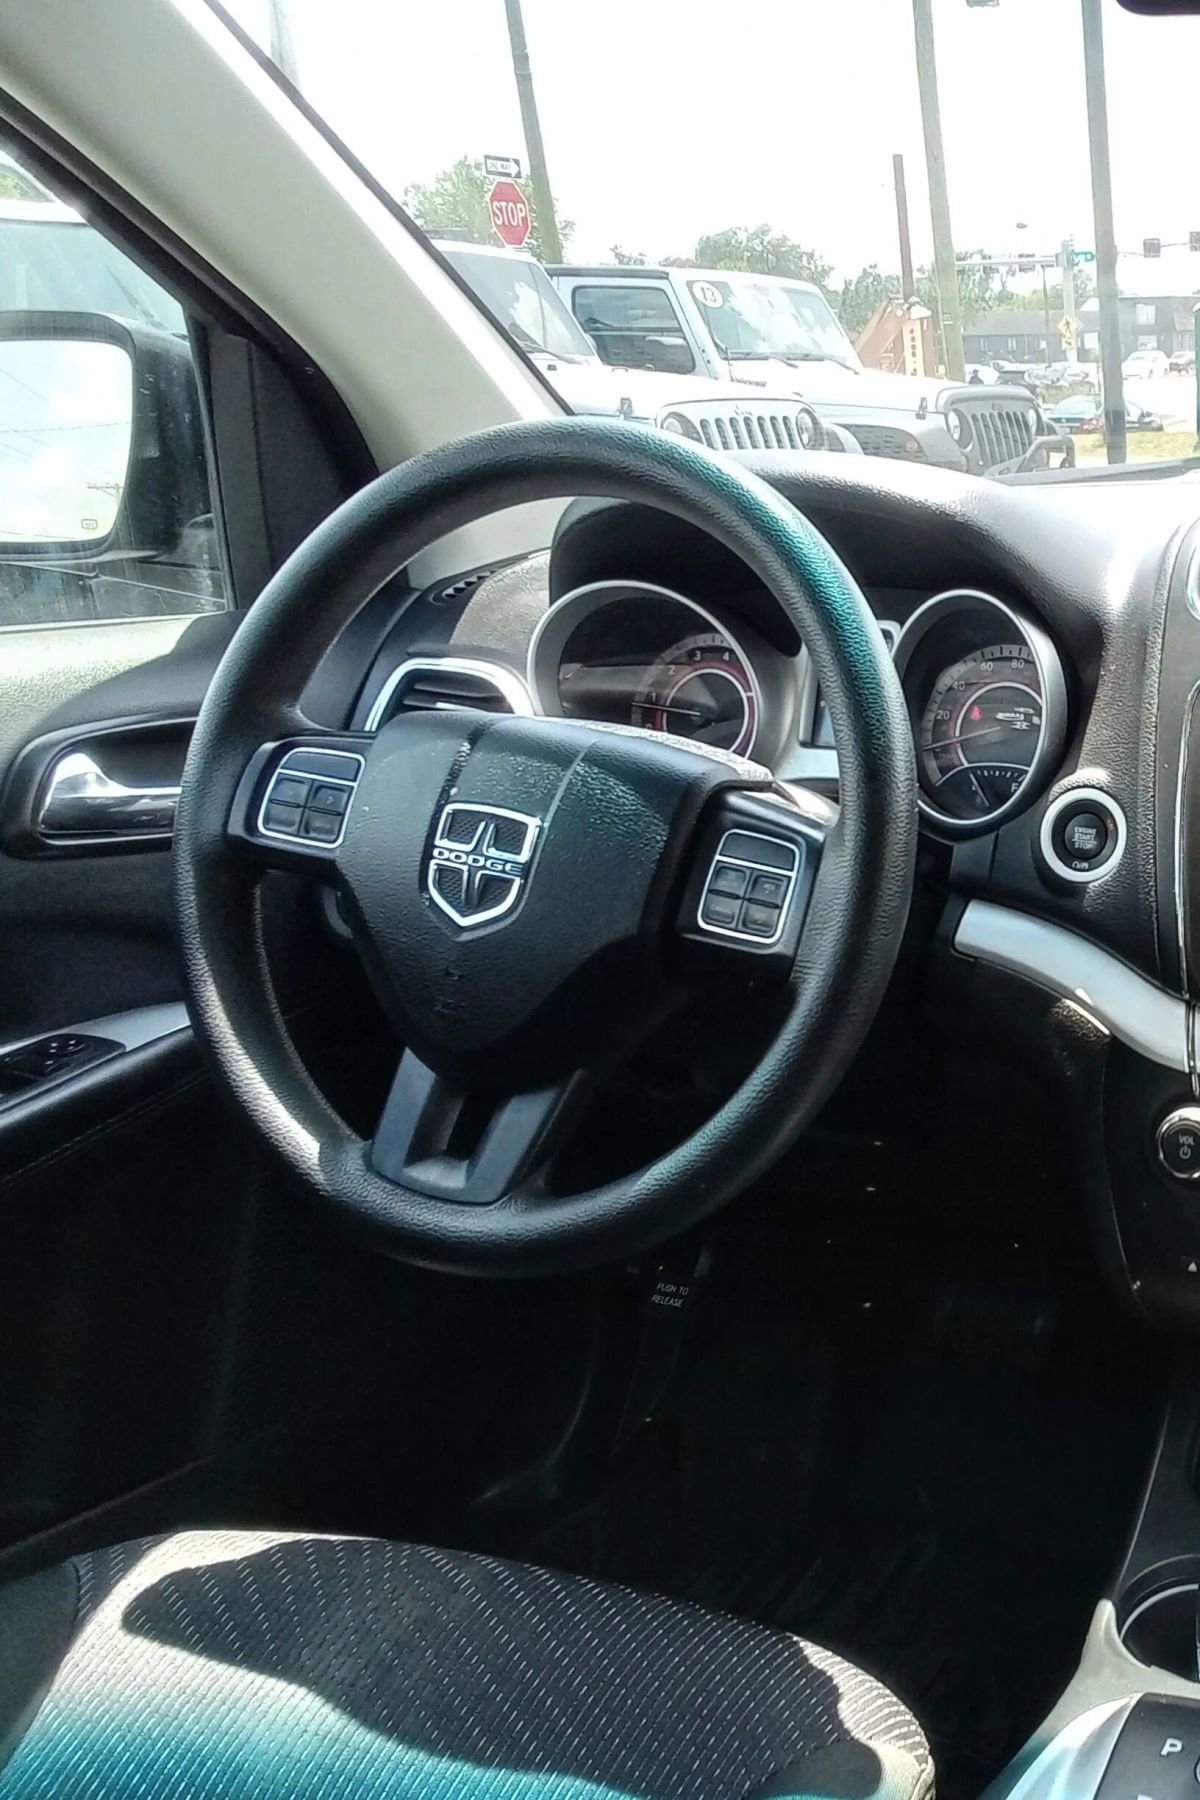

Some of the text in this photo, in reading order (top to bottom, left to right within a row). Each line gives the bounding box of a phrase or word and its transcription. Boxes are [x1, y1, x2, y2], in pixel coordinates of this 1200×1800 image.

[492, 201, 526, 227] STOP
[694, 650, 702, 662] 3
[722, 650, 730, 662] 4
[980, 662, 994, 672] 60
[1011, 659, 1025, 669] 80
[667, 665, 676, 676] 2
[935, 710, 950, 720] 20
[1010, 783, 1019, 793] F
[1074, 827, 1097, 835] ENGINE
[1074, 833, 1095, 841] START
[432, 848, 523, 875] DODGE
[1178, 1134, 1195, 1146] VOL
[656, 1282, 689, 1296] PUSH TO
[651, 1294, 684, 1308] RELEASE
[1160, 1737, 1183, 1757] P
